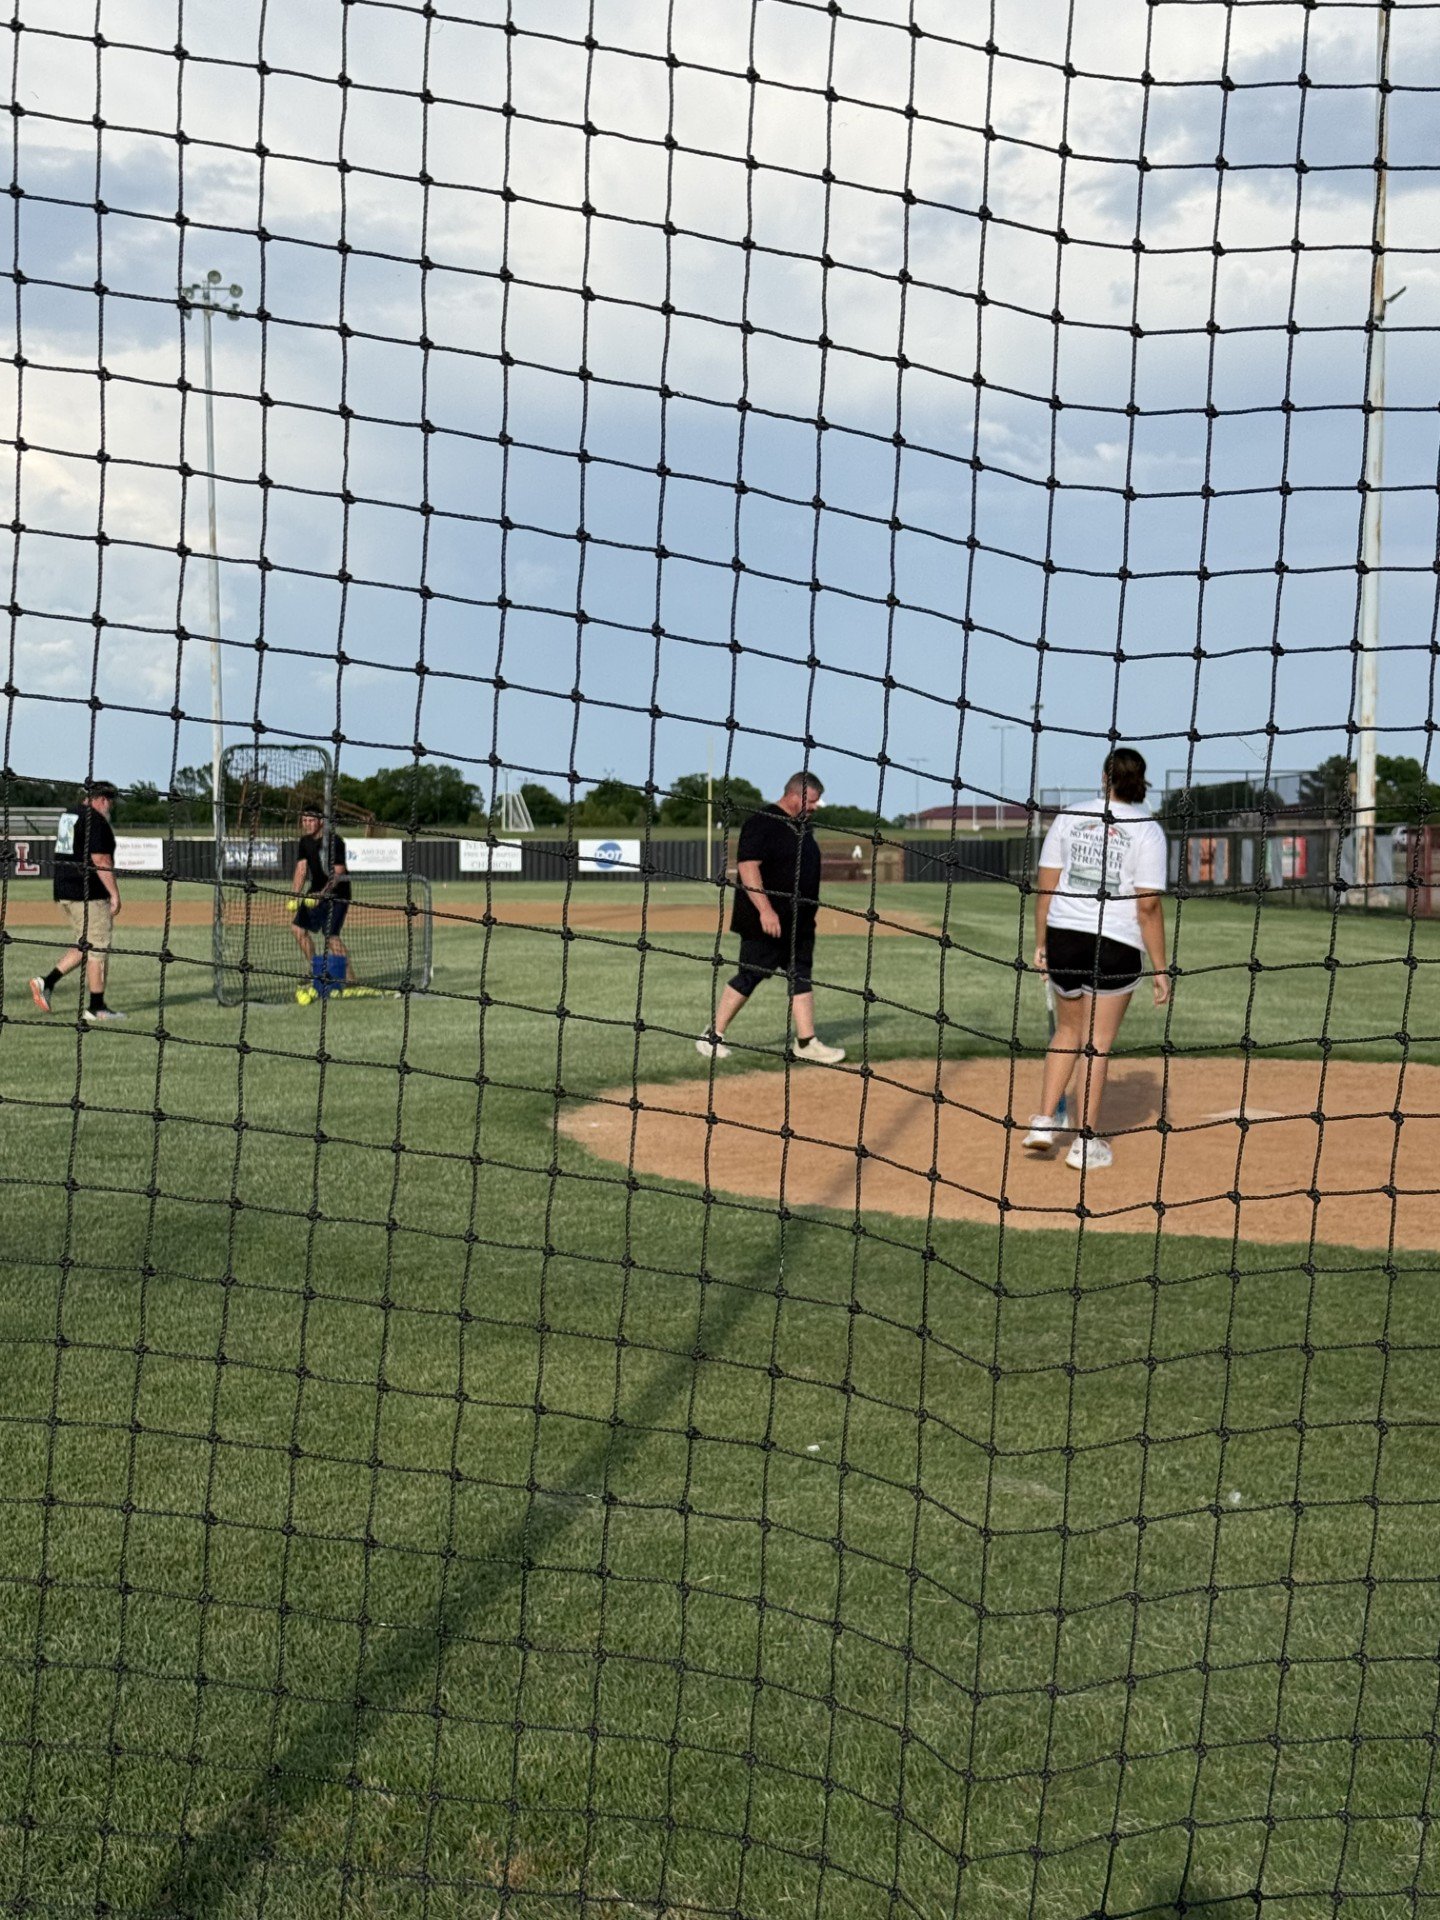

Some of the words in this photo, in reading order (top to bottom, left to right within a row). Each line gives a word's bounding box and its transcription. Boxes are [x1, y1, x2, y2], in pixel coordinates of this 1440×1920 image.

[15, 842, 40, 875] L
[1071, 843, 1123, 862] SHINLE
[1071, 853, 1122, 870] STRENTH
[471, 861, 512, 869] CHRCH
